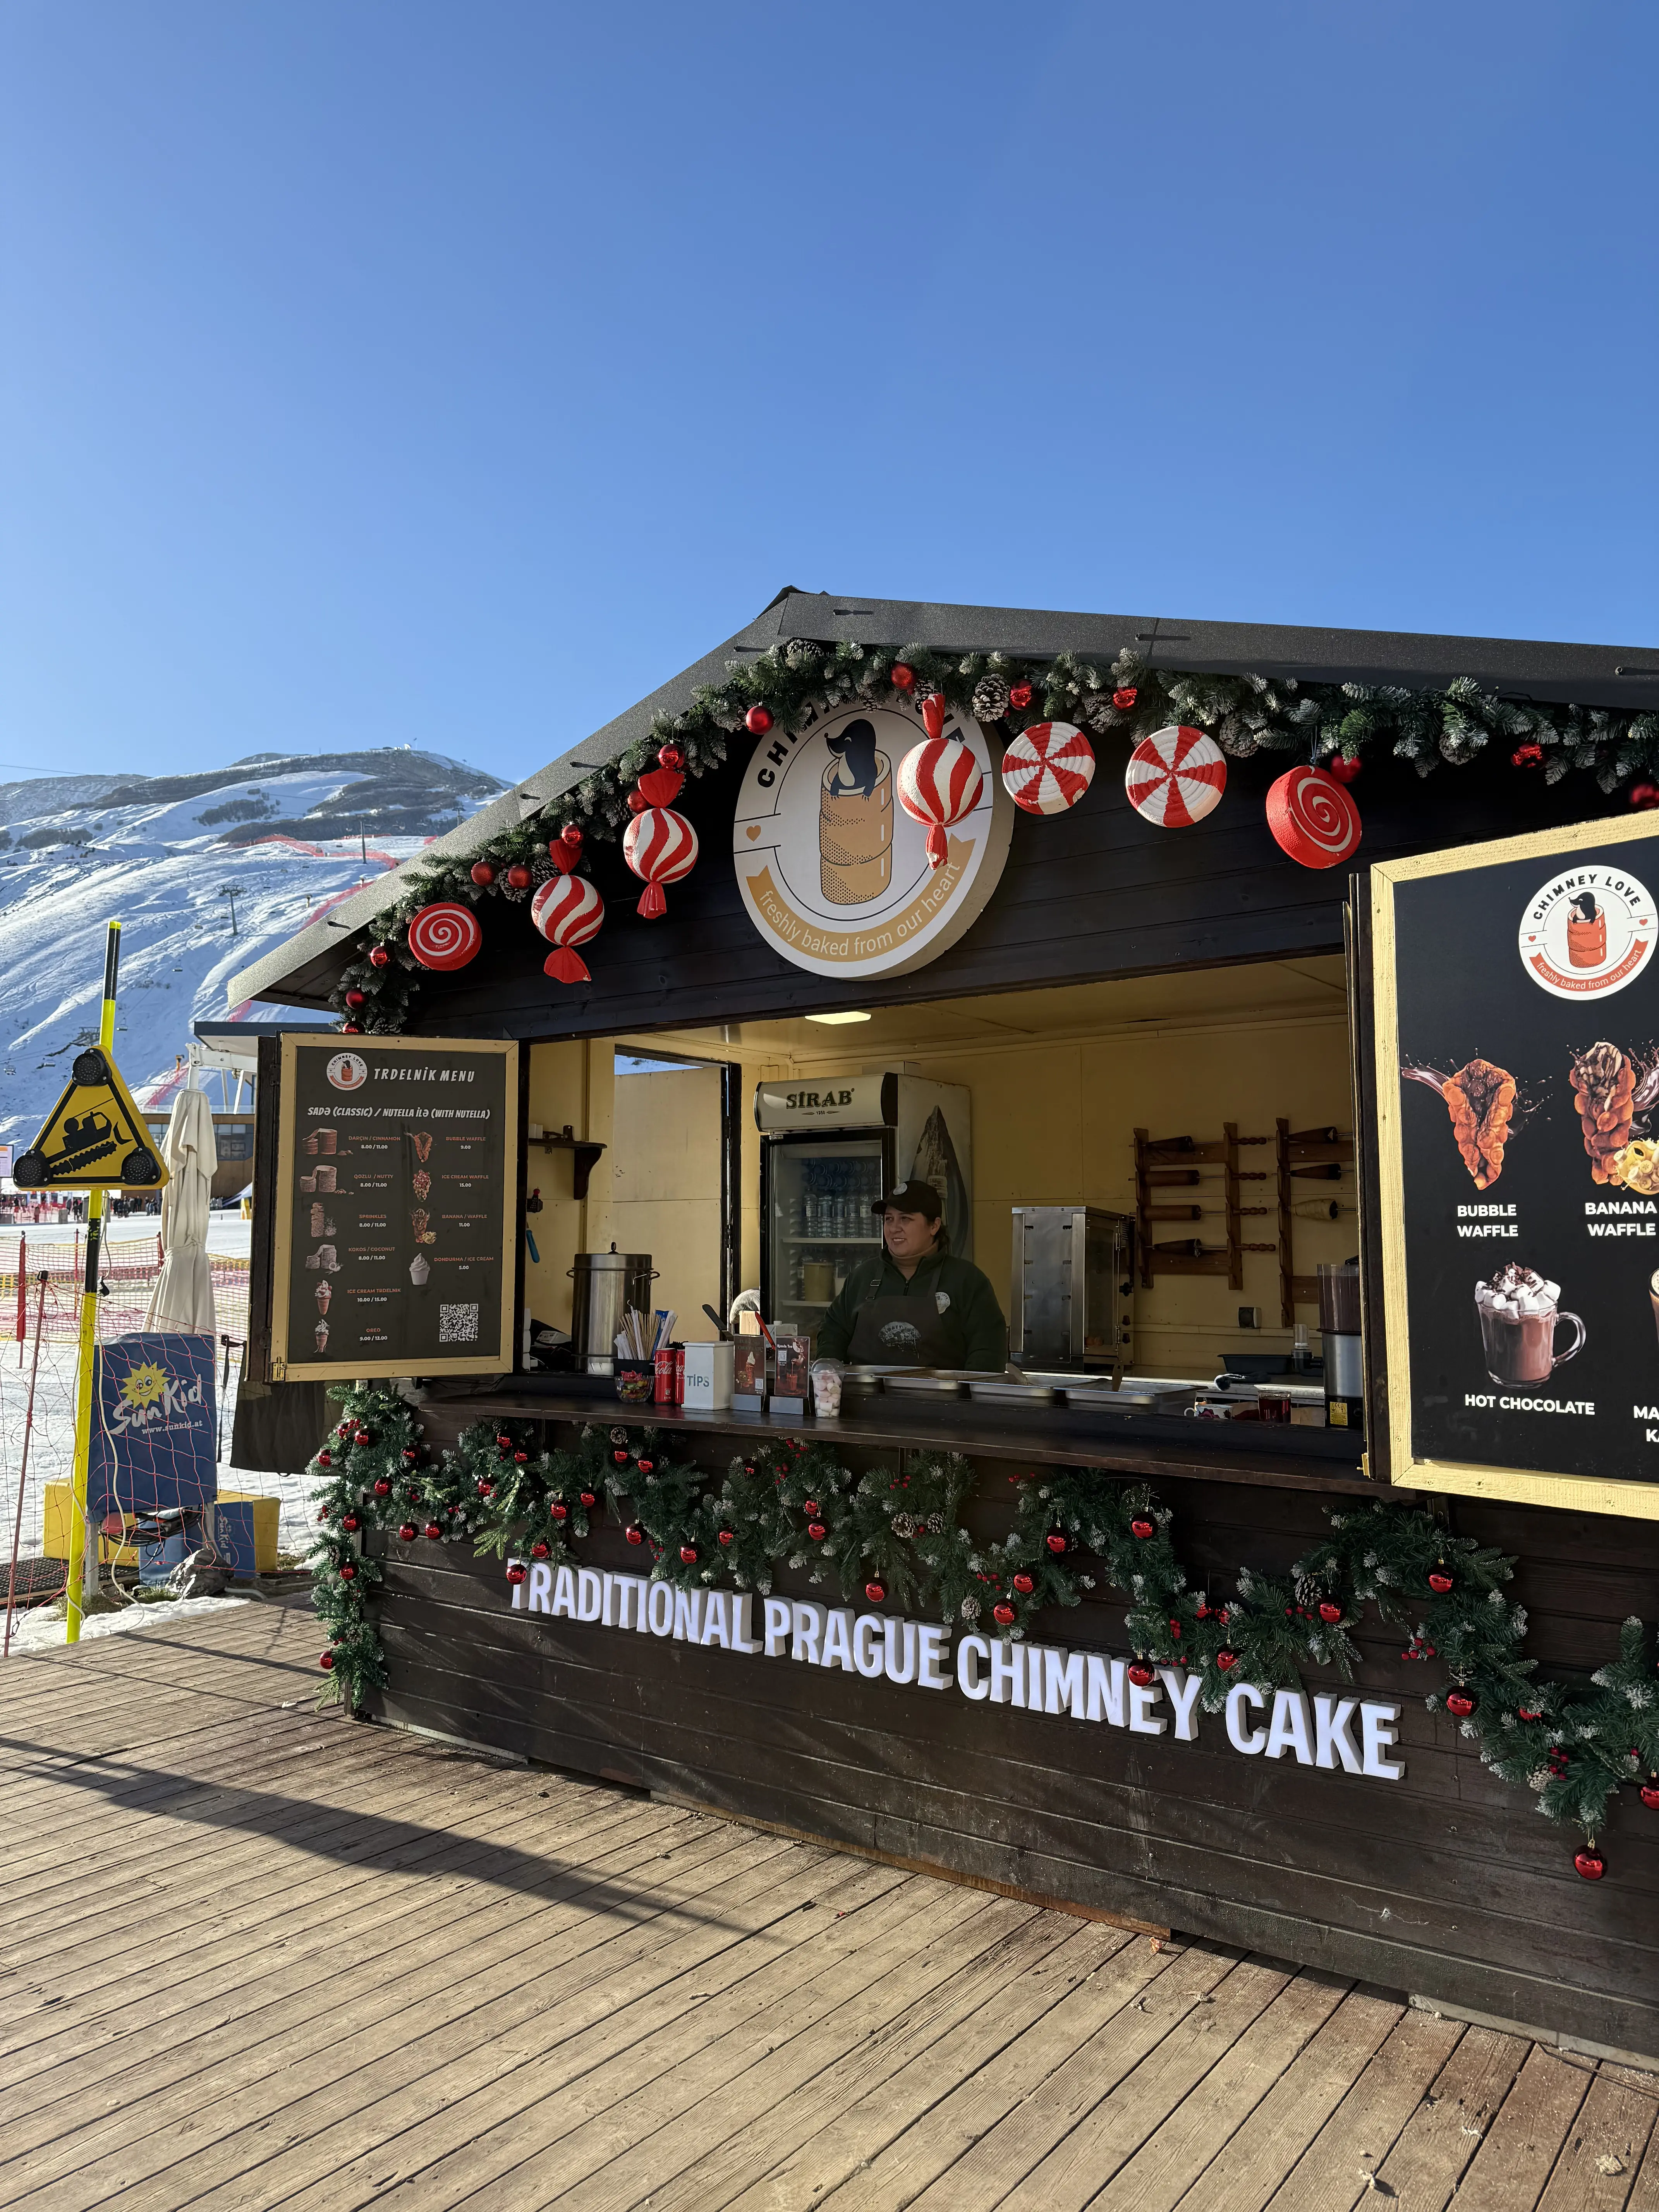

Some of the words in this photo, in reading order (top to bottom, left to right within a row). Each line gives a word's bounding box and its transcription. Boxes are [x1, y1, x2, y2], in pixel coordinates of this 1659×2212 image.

[1533, 874, 1597, 920] CHIMNEY
[1605, 876, 1641, 906] LOVE
[760, 890, 801, 942] freshly
[801, 929, 848, 956] baked
[854, 932, 893, 955] from
[897, 910, 923, 937] our
[921, 862, 960, 912] heart
[1537, 962, 1560, 984] freshly
[1560, 980, 1586, 989] baked
[1588, 979, 1609, 989] from
[1610, 969, 1623, 981] our
[1622, 949, 1642, 971] heart
[353, 1057, 363, 1066] LOVE
[374, 1067, 437, 1081] TRDELNİK
[439, 1070, 476, 1082] MENU
[786, 1091, 852, 1109] SİRAB
[333, 1106, 373, 1118] (CLASSIC)
[383, 1108, 414, 1117] NUTELLA
[431, 1108, 454, 1118] (WITH
[455, 1109, 490, 1120] NUTELLA)
[1457, 1204, 1517, 1217] BUBBLE
[1585, 1201, 1658, 1215] BANANA
[1457, 1225, 1518, 1237] WAFFLE
[1587, 1223, 1656, 1237] WAFFLE
[1465, 1394, 1497, 1408] HOT
[1499, 1397, 1595, 1415] CHOCOLATE
[141, 1420, 203, 1434] www.sunkid.at
[1646, 1429, 1659, 1443] K
[763, 1594, 955, 1690] PRAGUE
[1225, 1681, 1406, 1781] CAKE
